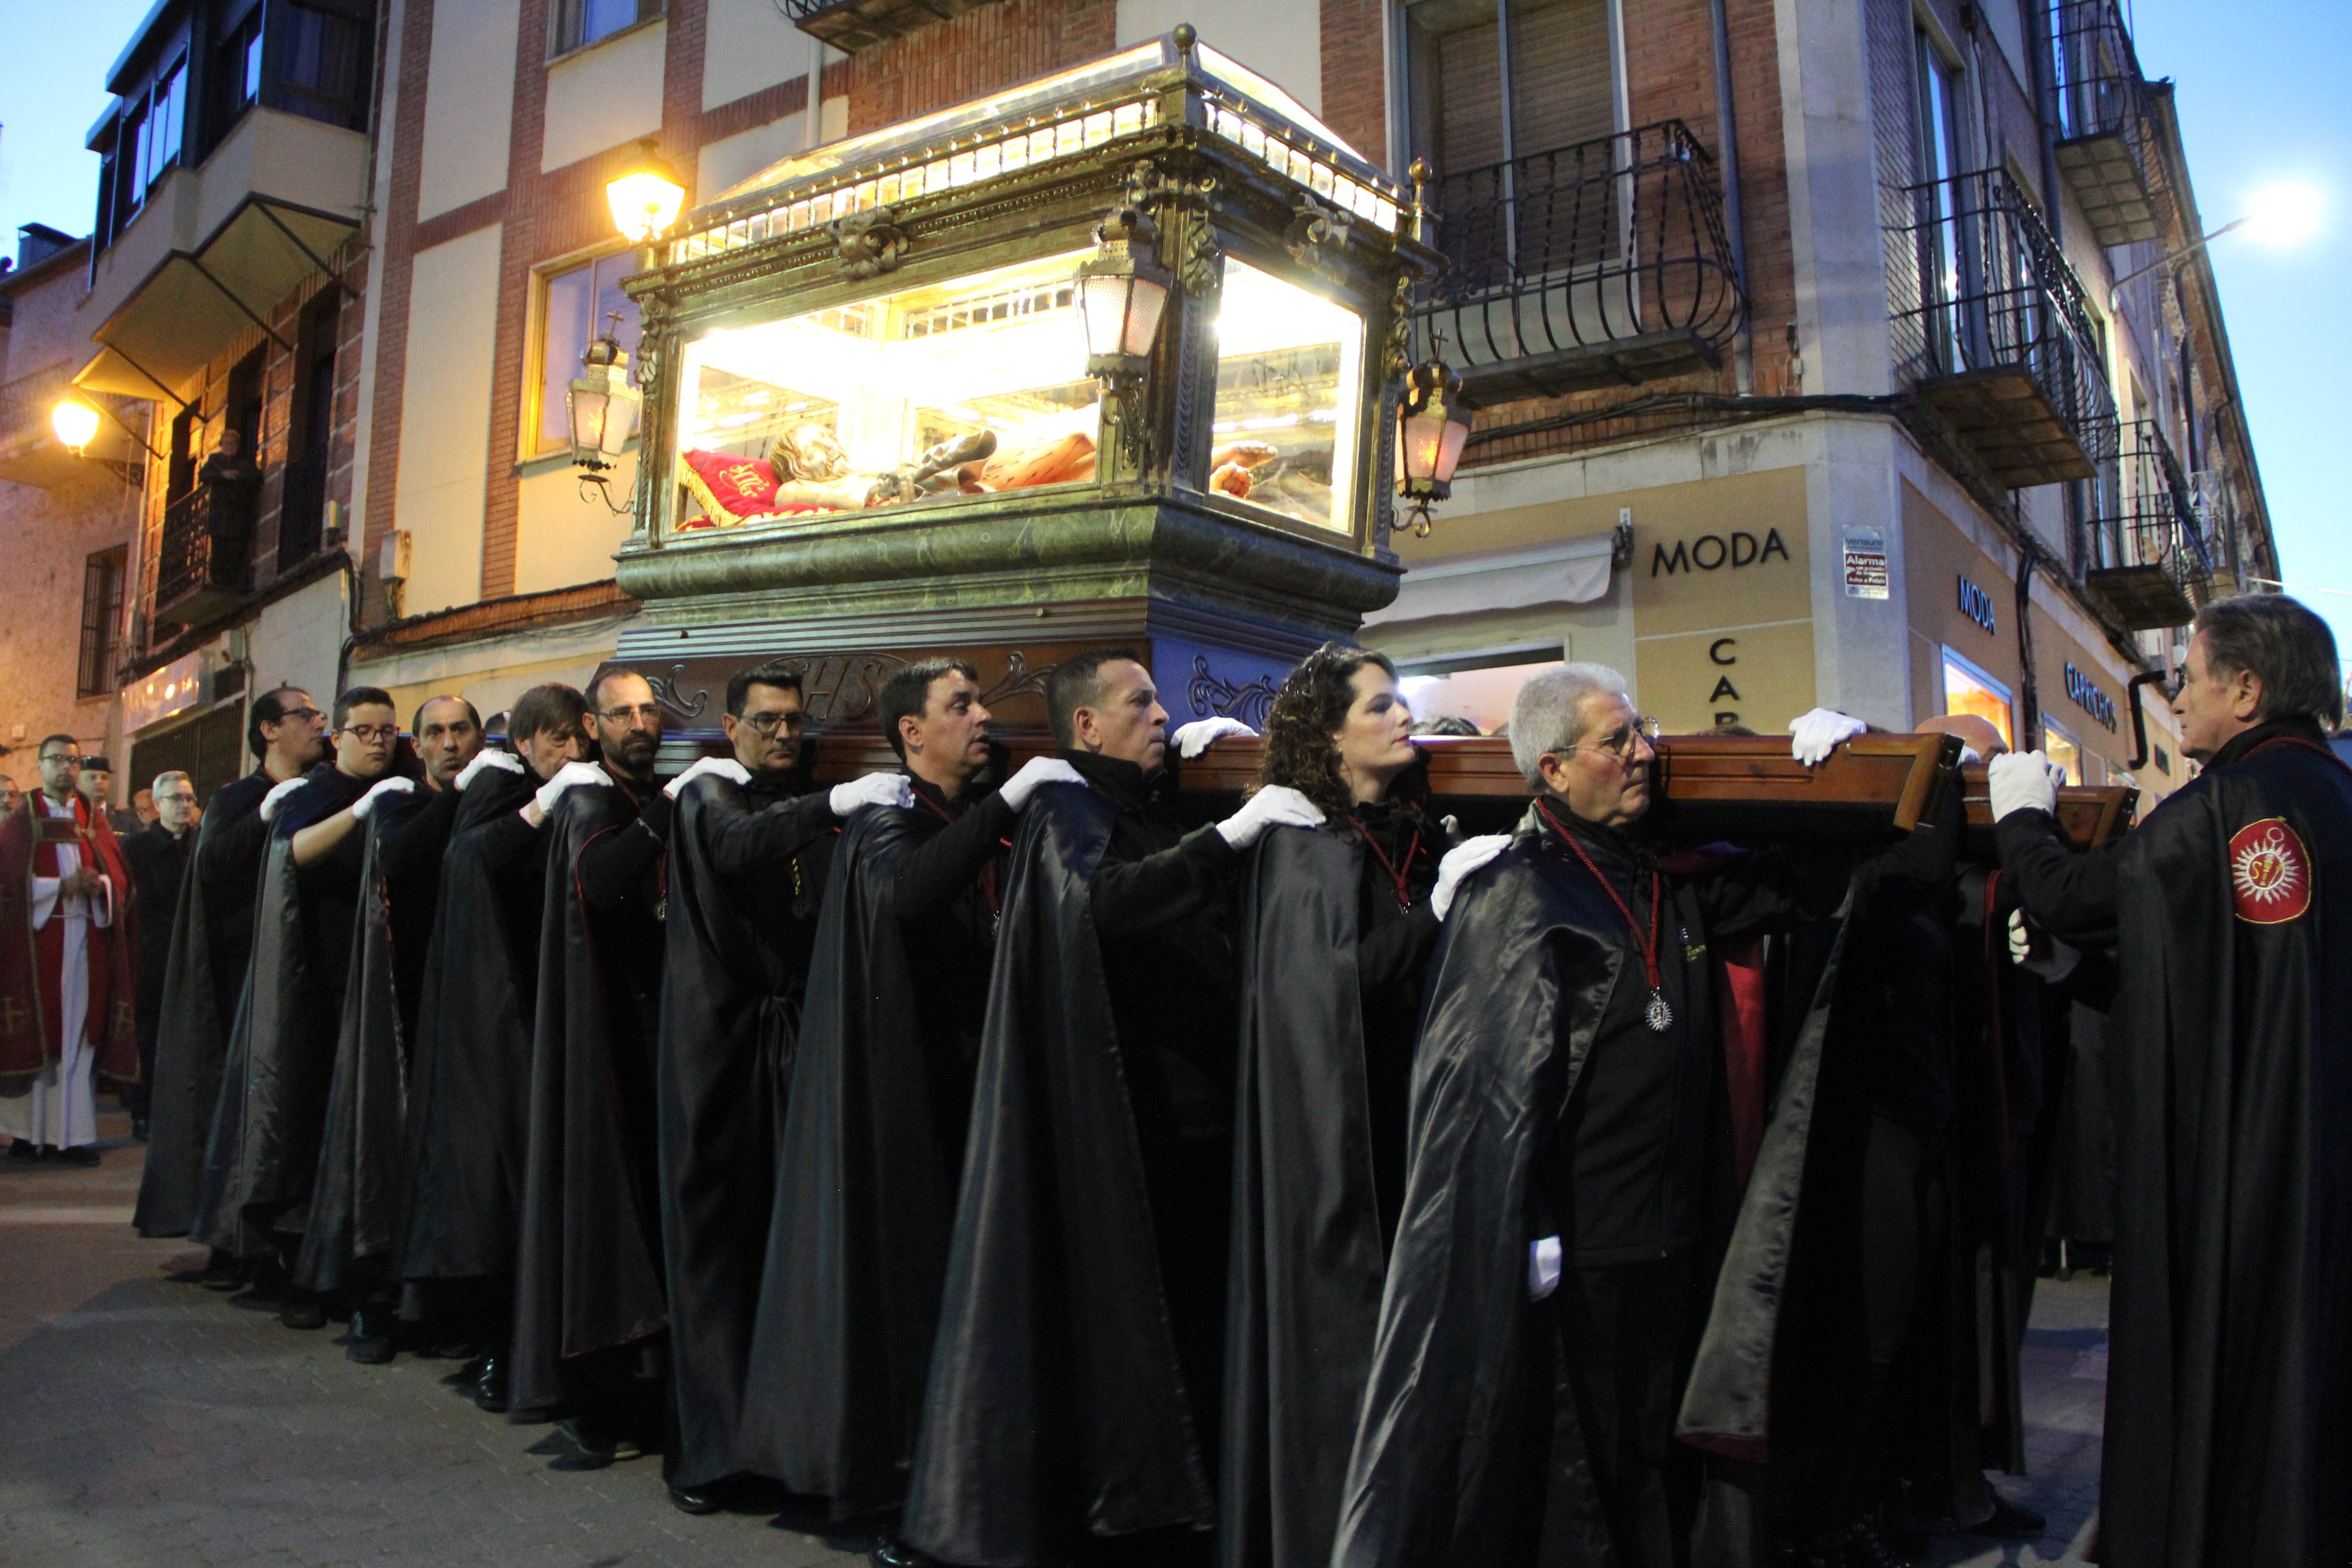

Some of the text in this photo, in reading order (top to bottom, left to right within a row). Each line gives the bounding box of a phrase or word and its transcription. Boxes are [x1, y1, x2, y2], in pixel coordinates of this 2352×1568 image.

[1652, 527, 1789, 577] MODA
[1846, 555, 1884, 566] Alarma
[1957, 574, 1996, 636] MODA
